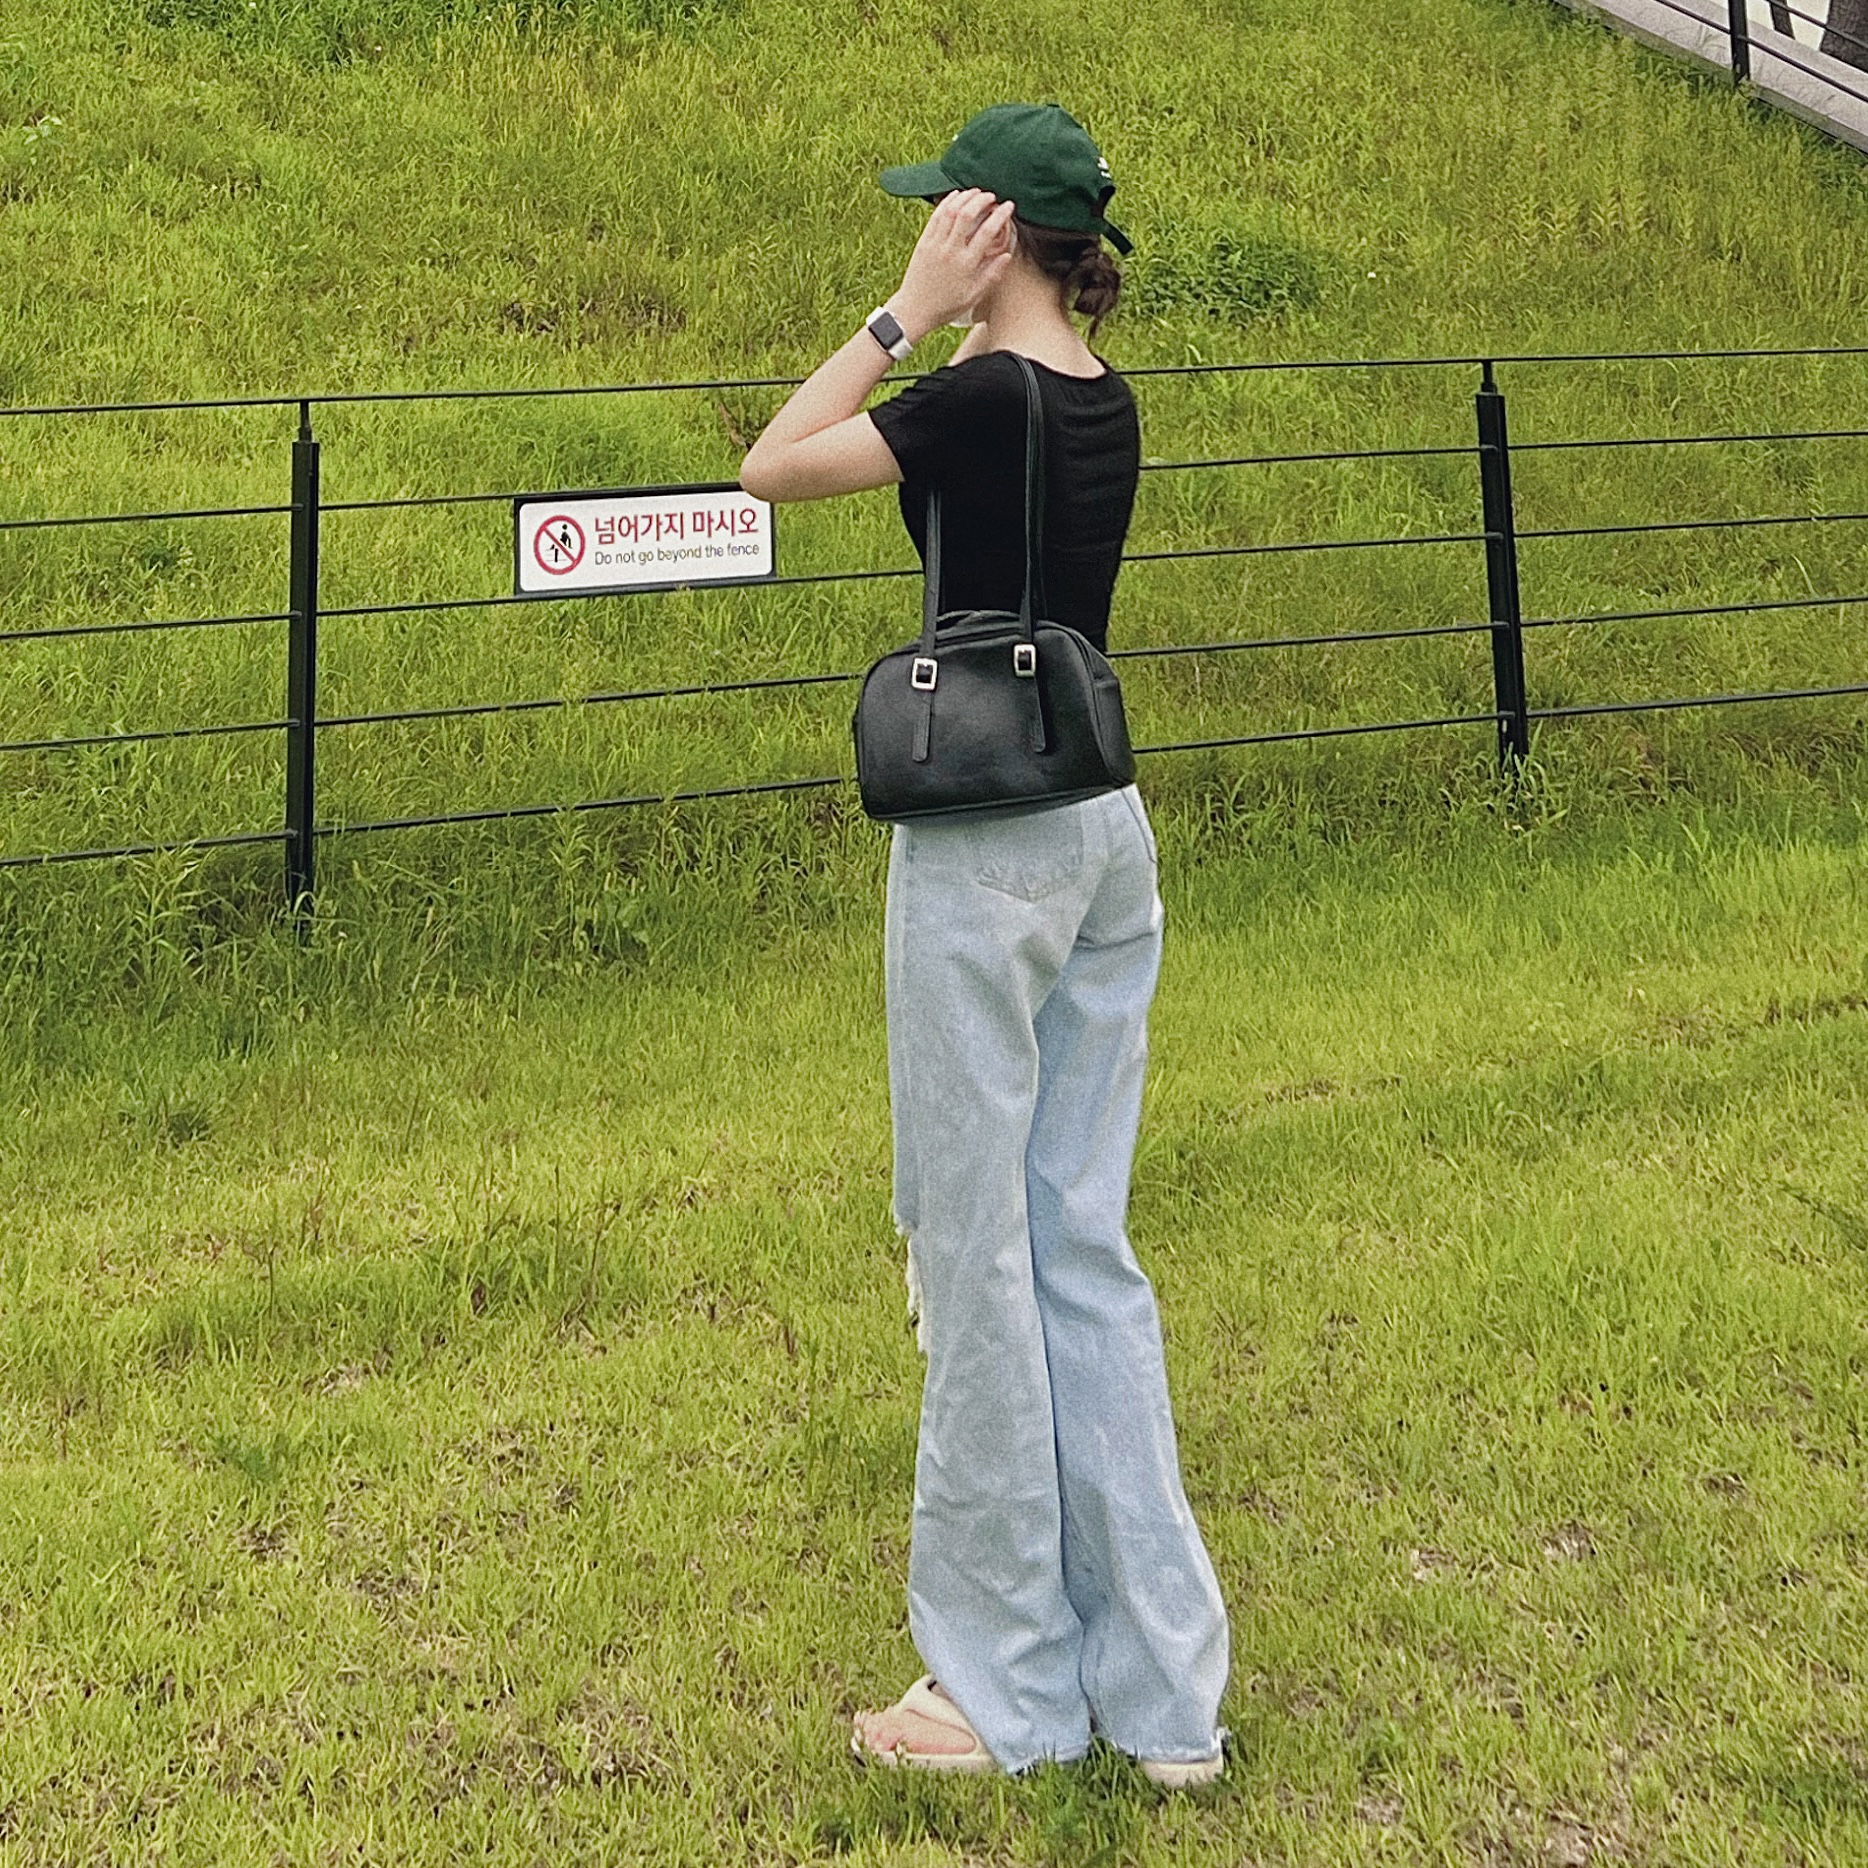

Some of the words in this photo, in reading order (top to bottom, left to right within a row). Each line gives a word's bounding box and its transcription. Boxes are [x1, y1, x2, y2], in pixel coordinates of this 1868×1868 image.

[595, 511, 684, 545] 넘어가지
[692, 508, 759, 538] 마시오
[595, 551, 612, 566] Do
[616, 549, 635, 564] not
[638, 551, 654, 566] go
[657, 545, 702, 564] beyond
[705, 544, 724, 558] the
[727, 543, 760, 557] fence
